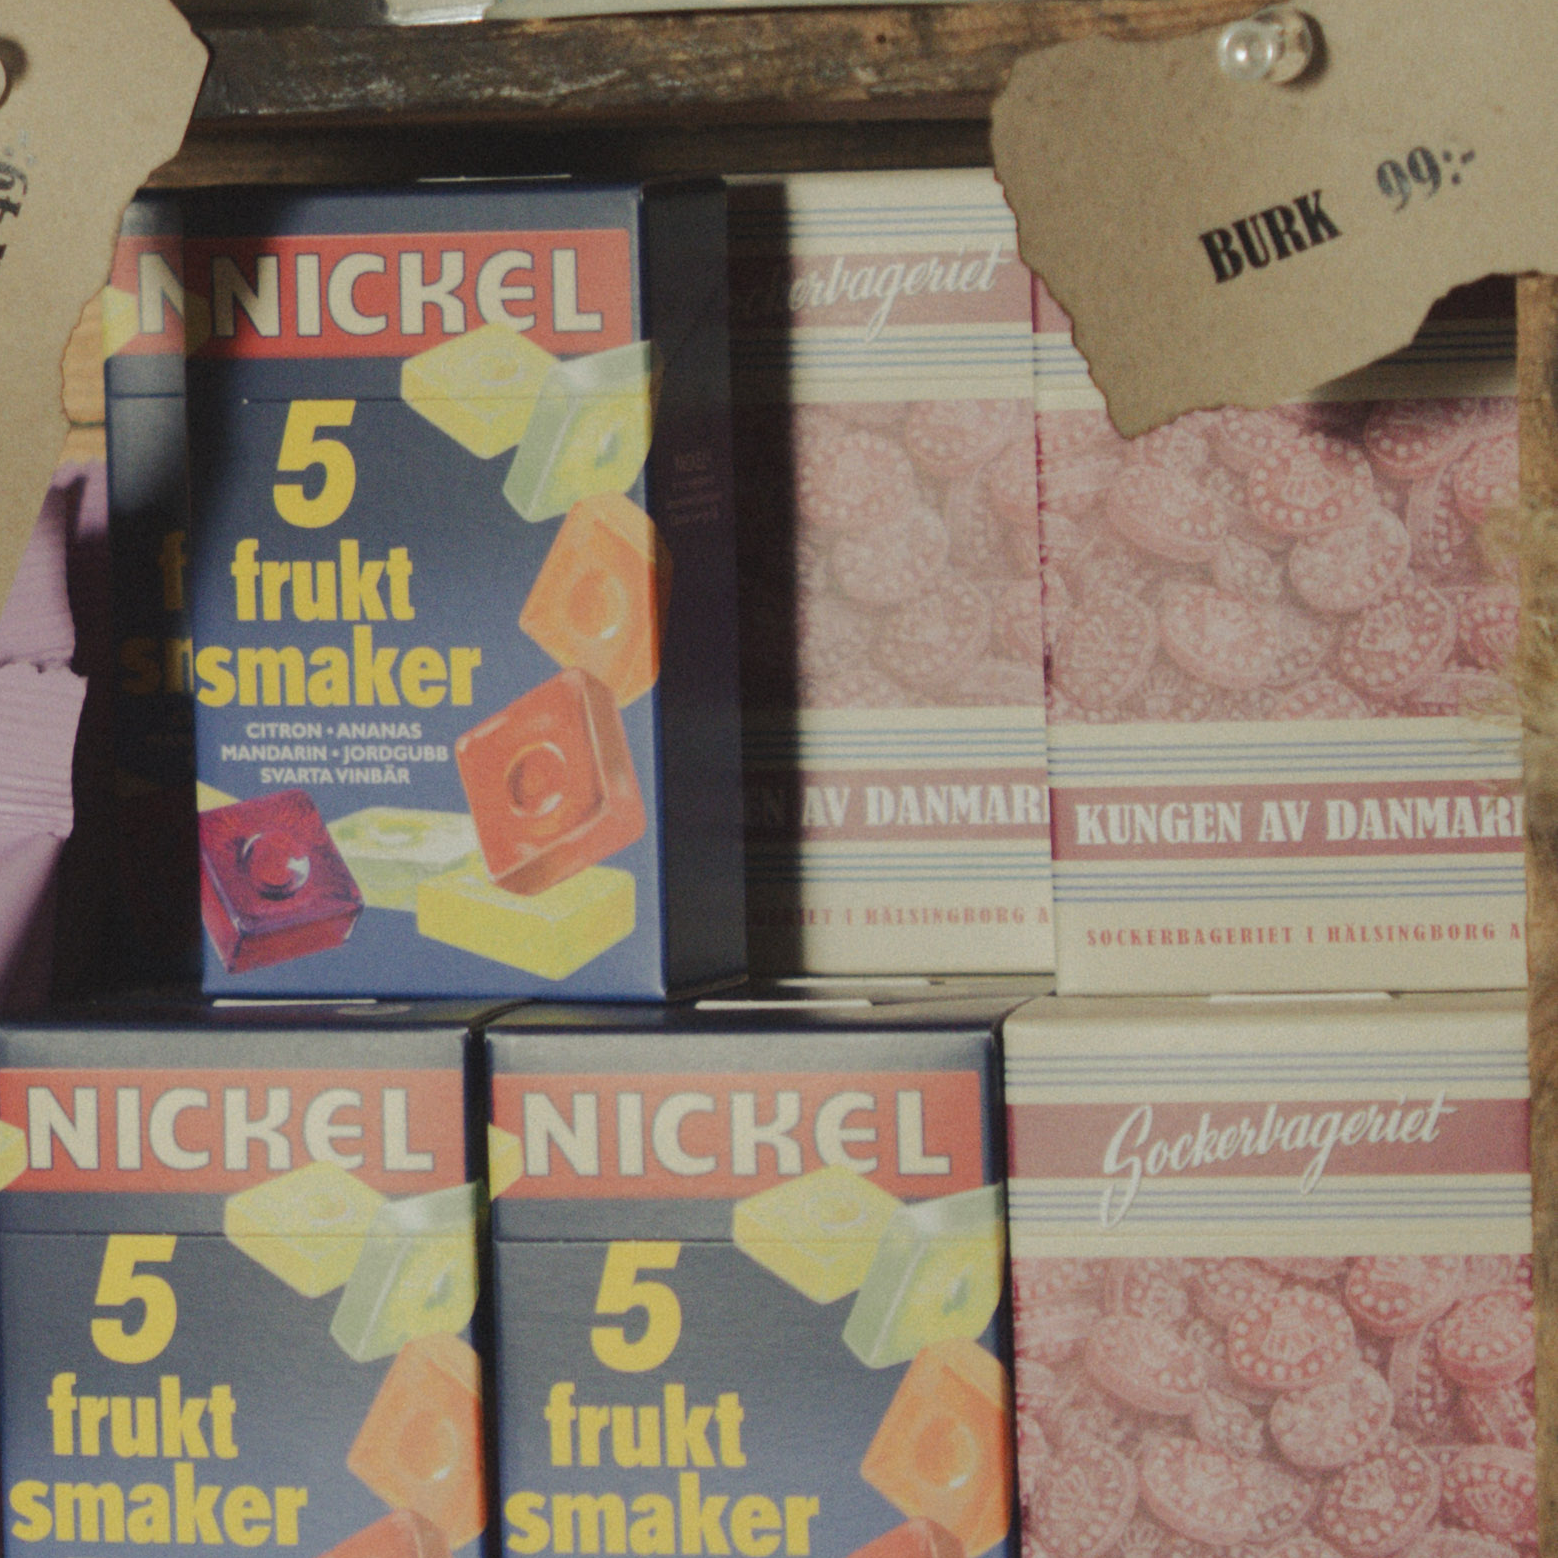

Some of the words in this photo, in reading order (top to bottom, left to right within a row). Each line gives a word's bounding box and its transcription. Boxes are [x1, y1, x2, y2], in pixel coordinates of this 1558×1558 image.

[1198, 189, 1343, 285] BURK
[1376, 144, 1476, 213] 99:-
[210, 247, 604, 337] NICKEL
[787, 241, 1014, 345] erbageriet
[272, 400, 357, 530] 5
[230, 538, 416, 623] frukt
[196, 624, 482, 708] smaker
[220, 745, 329, 764] MANDARIN
[342, 744, 449, 764] JORDGUBB
[246, 723, 324, 741] CITRON
[336, 722, 423, 741] ANANAS
[260, 768, 332, 786] SVARTA
[333, 765, 411, 786] VINBÄR
[802, 786, 852, 827] AV
[865, 784, 1050, 826] DANMAR
[1075, 801, 1244, 847] KUNGEN
[1258, 800, 1312, 844] AV
[1087, 926, 1293, 947] SOCKERBAGERIET
[1306, 925, 1315, 943] I
[1326, 920, 1498, 944] HÄLSINGBORG
[1509, 923, 1523, 942] A
[26, 1086, 435, 1172] NICKEL
[521, 1089, 952, 1177] NICKEL
[1098, 1089, 1458, 1232] Sockerbageriet
[89, 1234, 178, 1365] 5
[589, 1240, 683, 1374] 5
[47, 1372, 240, 1461] frukt
[543, 1382, 748, 1469] frukt
[8, 1462, 308, 1547] smaker
[503, 1471, 820, 1557] smaker
